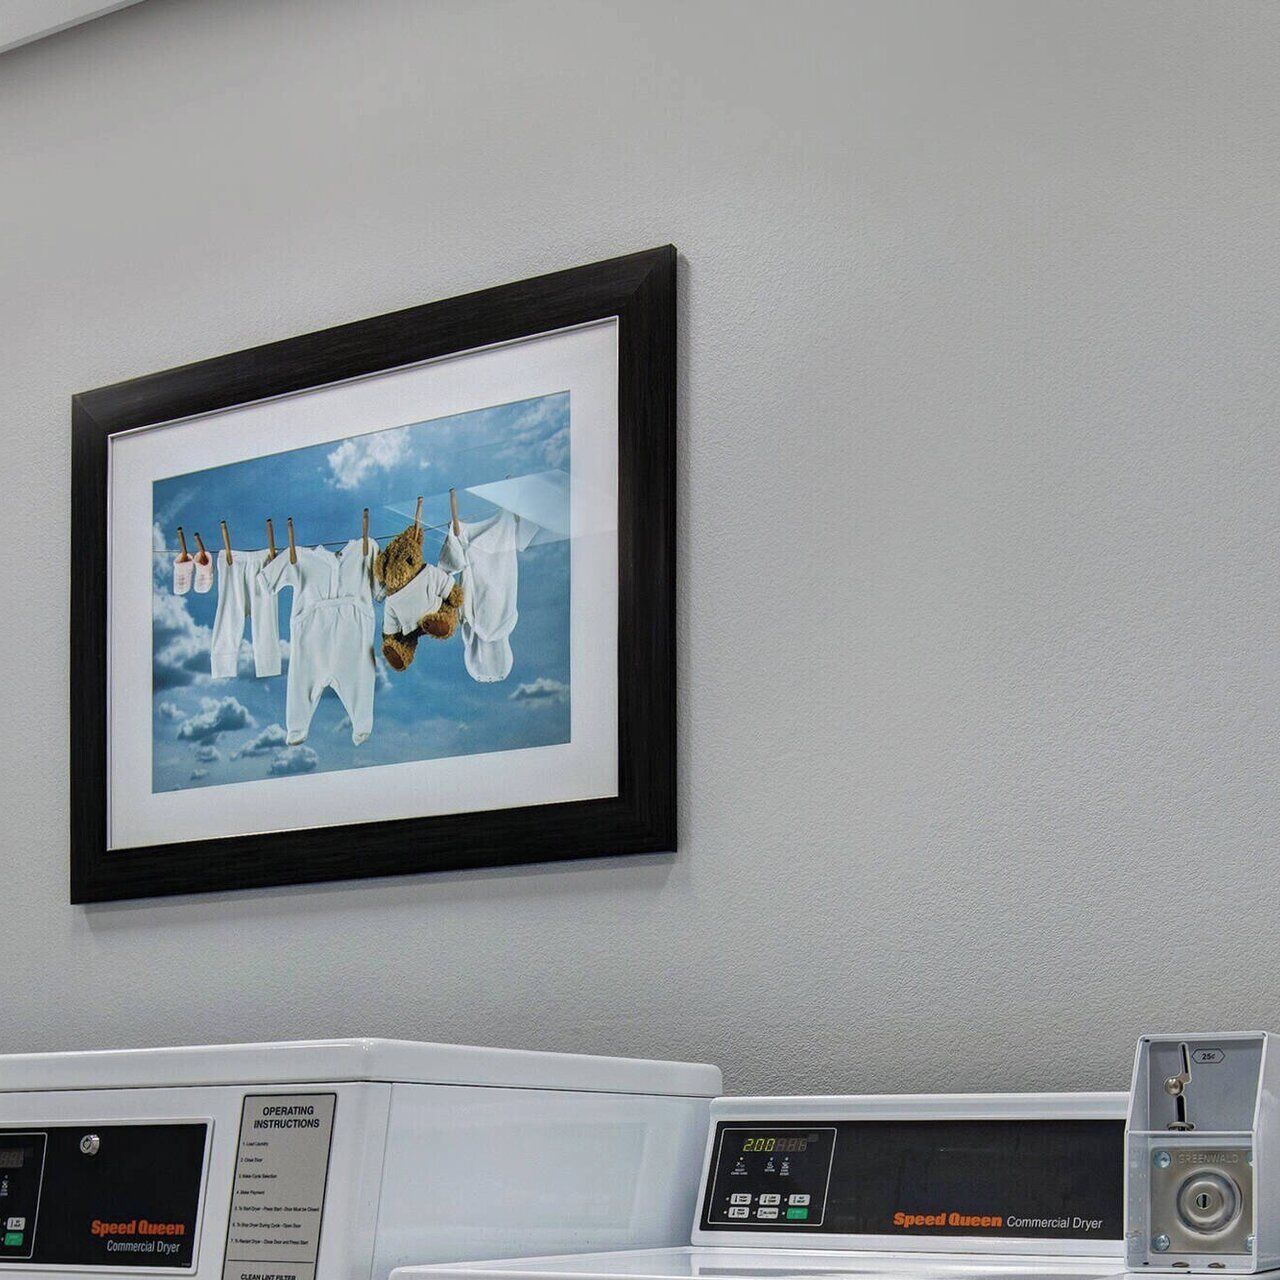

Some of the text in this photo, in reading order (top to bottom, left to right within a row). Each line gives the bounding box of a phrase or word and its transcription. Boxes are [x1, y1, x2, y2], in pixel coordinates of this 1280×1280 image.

[262, 1105, 314, 1116] OPERATING
[254, 1118, 320, 1129] INSTRUCTIONS
[893, 1211, 1103, 1231] Speed Queen Commercial Dryer
[91, 1219, 185, 1237] Speed Queen
[106, 1240, 180, 1255] Commercial Dryer
[240, 1273, 260, 1280] CLEAN
